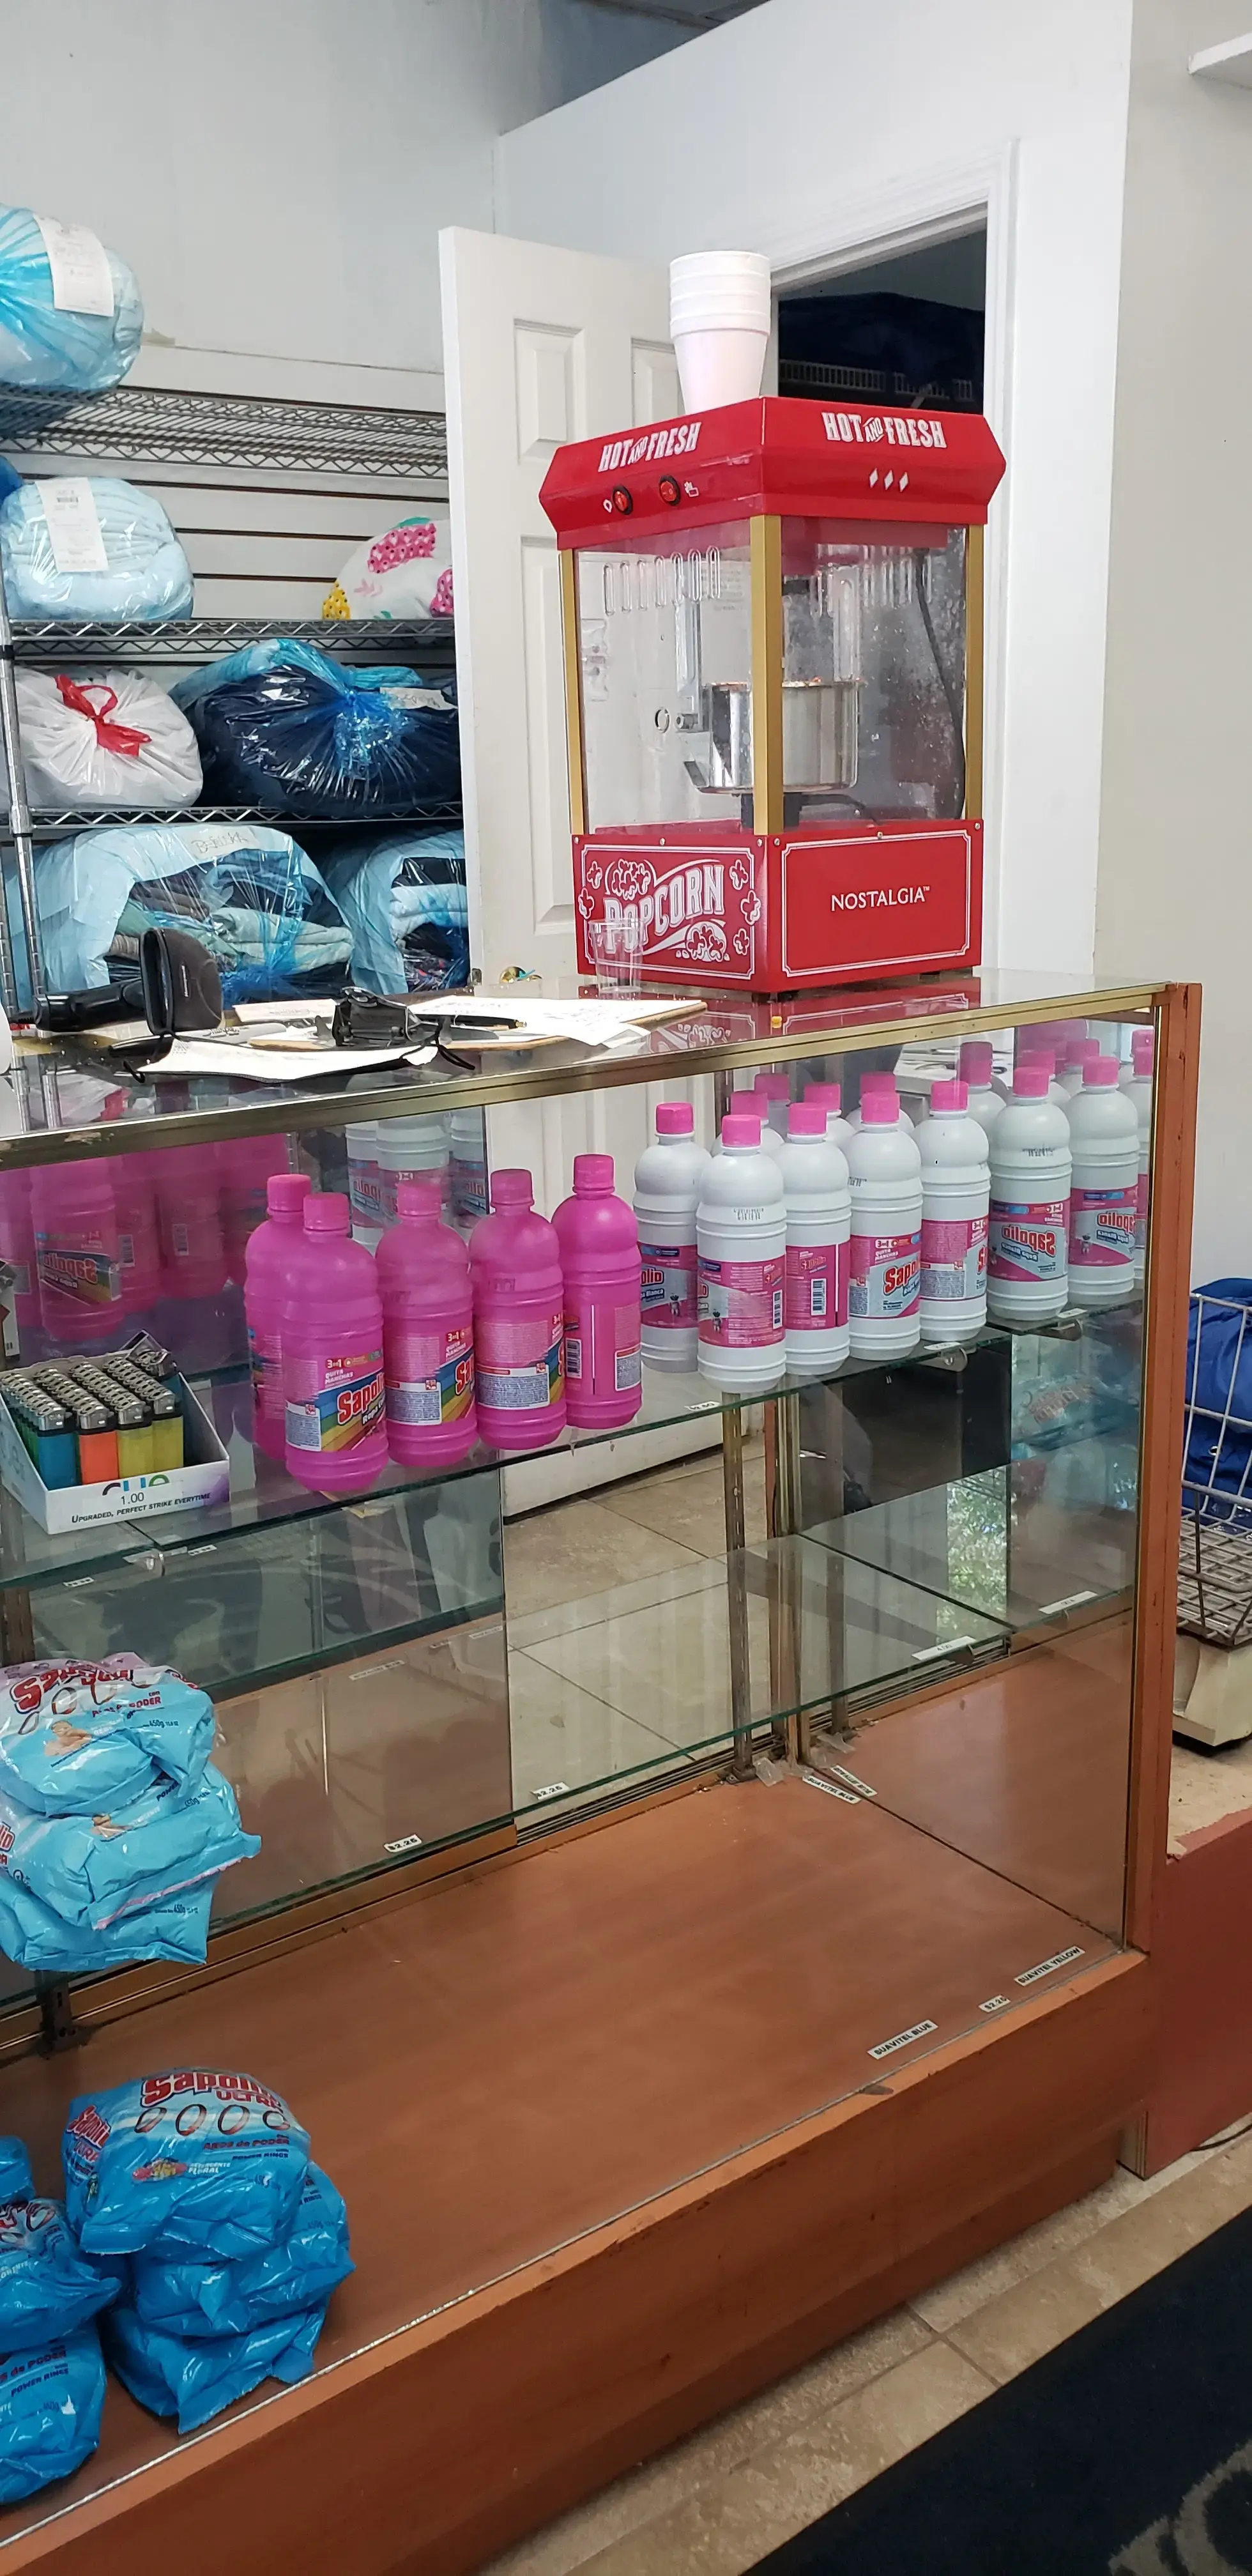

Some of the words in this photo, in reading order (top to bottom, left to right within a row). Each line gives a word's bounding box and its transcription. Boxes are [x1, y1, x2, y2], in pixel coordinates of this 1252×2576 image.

[821, 411, 864, 442] HOT
[864, 417, 883, 443] AND
[883, 416, 947, 448] FRESH
[598, 438, 634, 472] HOT
[627, 436, 648, 464] AND
[645, 422, 702, 461] FRESH
[603, 864, 724, 954] POPCORN
[641, 1268, 664, 1285] olio
[121, 1492, 144, 1505] 1.00
[149, 1719, 165, 1728] 450g
[1018, 1963, 1053, 1984] SUAVITEL
[1050, 1947, 1081, 1966] YELLOW
[874, 2032, 913, 2055] SUAVITEL
[911, 2022, 933, 2036] BLUE
[11, 2376, 42, 2398] POWER
[43, 2367, 69, 2382] RINGS
